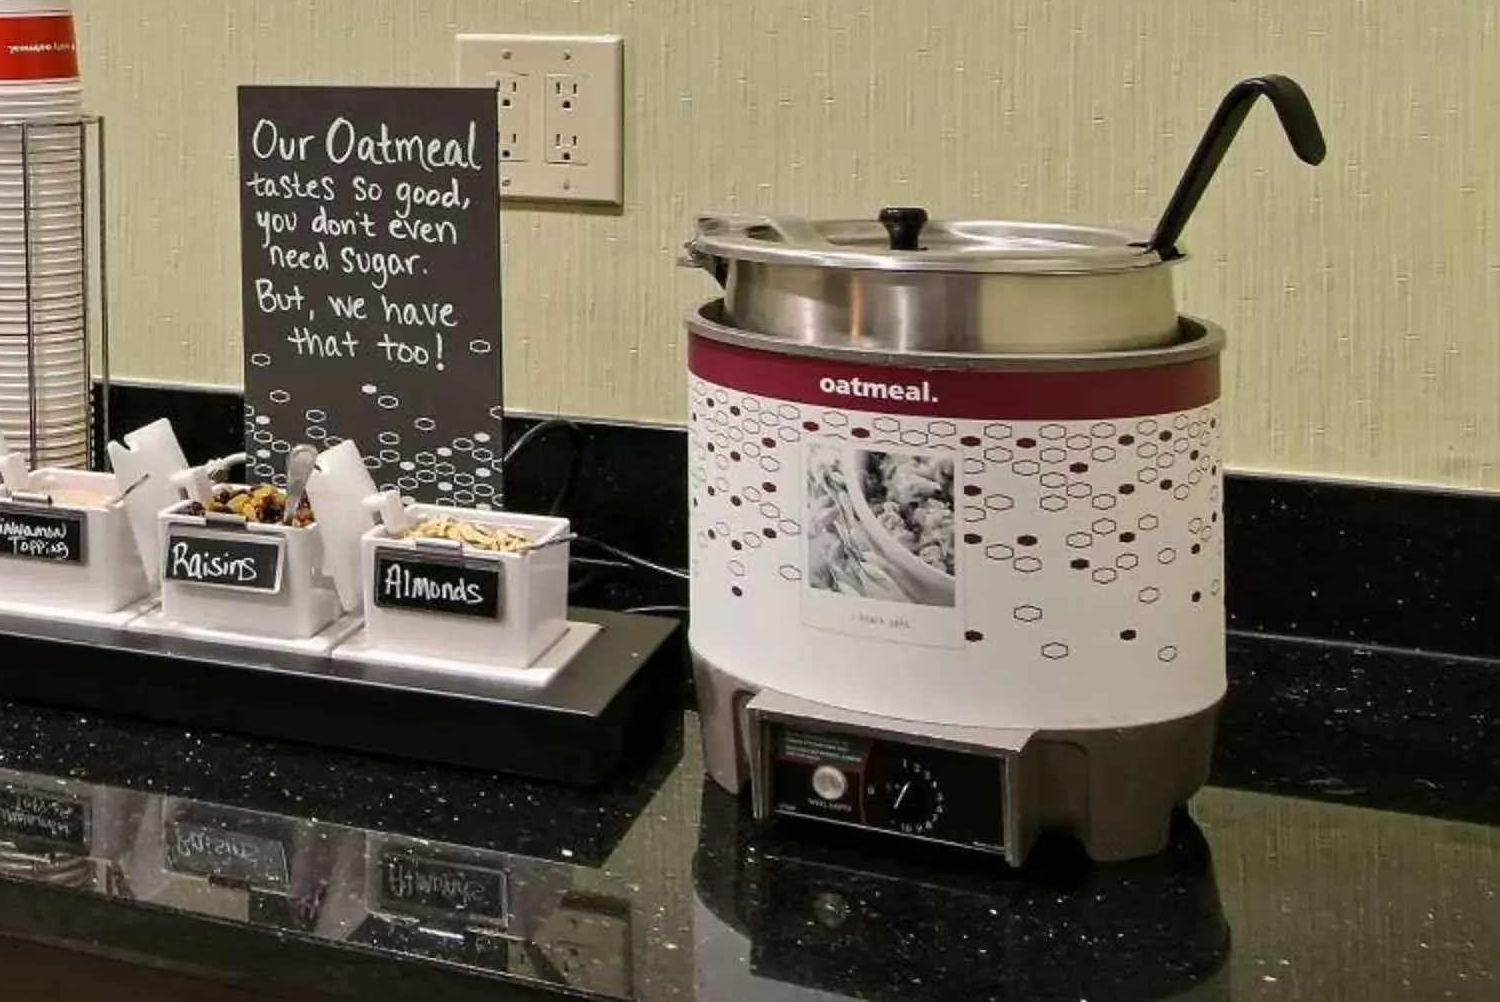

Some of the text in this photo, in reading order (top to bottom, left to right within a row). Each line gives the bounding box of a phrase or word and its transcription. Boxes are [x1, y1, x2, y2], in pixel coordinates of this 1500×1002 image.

[252, 116, 482, 173] Our Oatmeal
[246, 171, 336, 201] tastes
[395, 177, 471, 218] good,
[256, 205, 457, 248] you don't even
[269, 242, 329, 271] need
[255, 278, 458, 327] But, we have
[287, 326, 445, 371] that too!
[819, 376, 939, 403] oatmeal.
[172, 541, 257, 581] Raisins
[385, 563, 484, 604] Almonds
